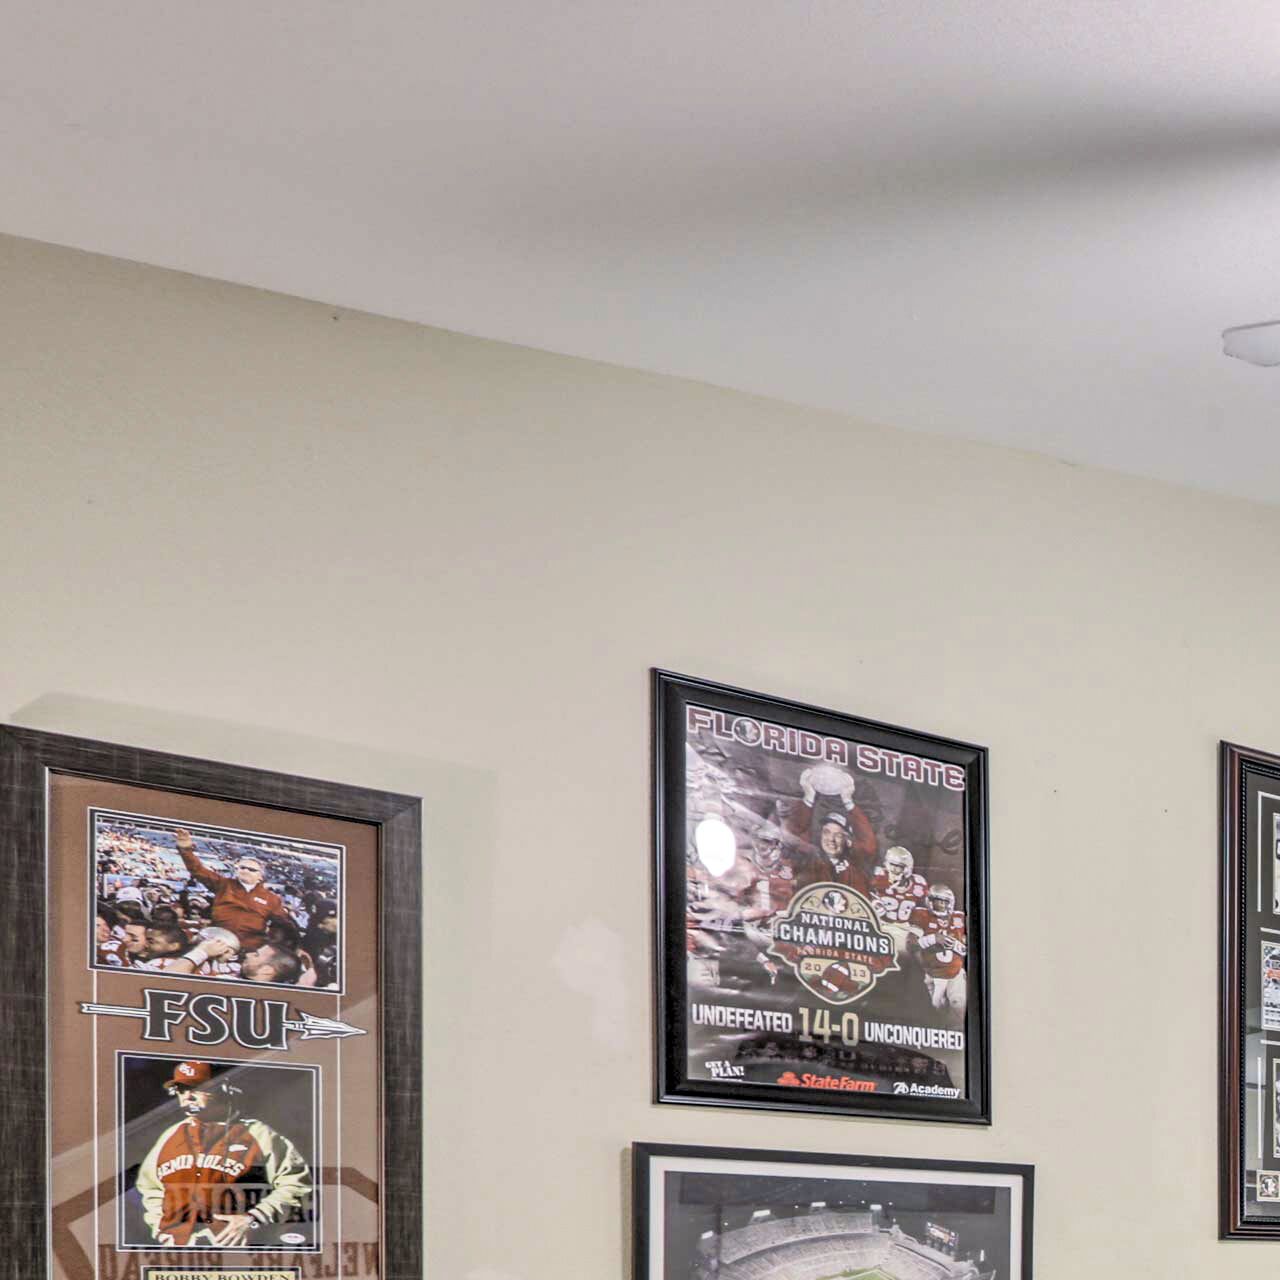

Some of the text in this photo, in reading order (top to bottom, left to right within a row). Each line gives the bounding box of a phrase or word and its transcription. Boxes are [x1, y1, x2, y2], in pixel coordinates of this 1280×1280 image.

[686, 705, 966, 792] FLORIDA STATE
[780, 923, 890, 955] CHAMPIONS
[801, 912, 870, 933] NATIONAL
[141, 988, 290, 1051] FSU
[692, 1003, 965, 1051] UNDEFEATED 14-0 UNCONQUERED
[909, 1082, 961, 1099] Academy
